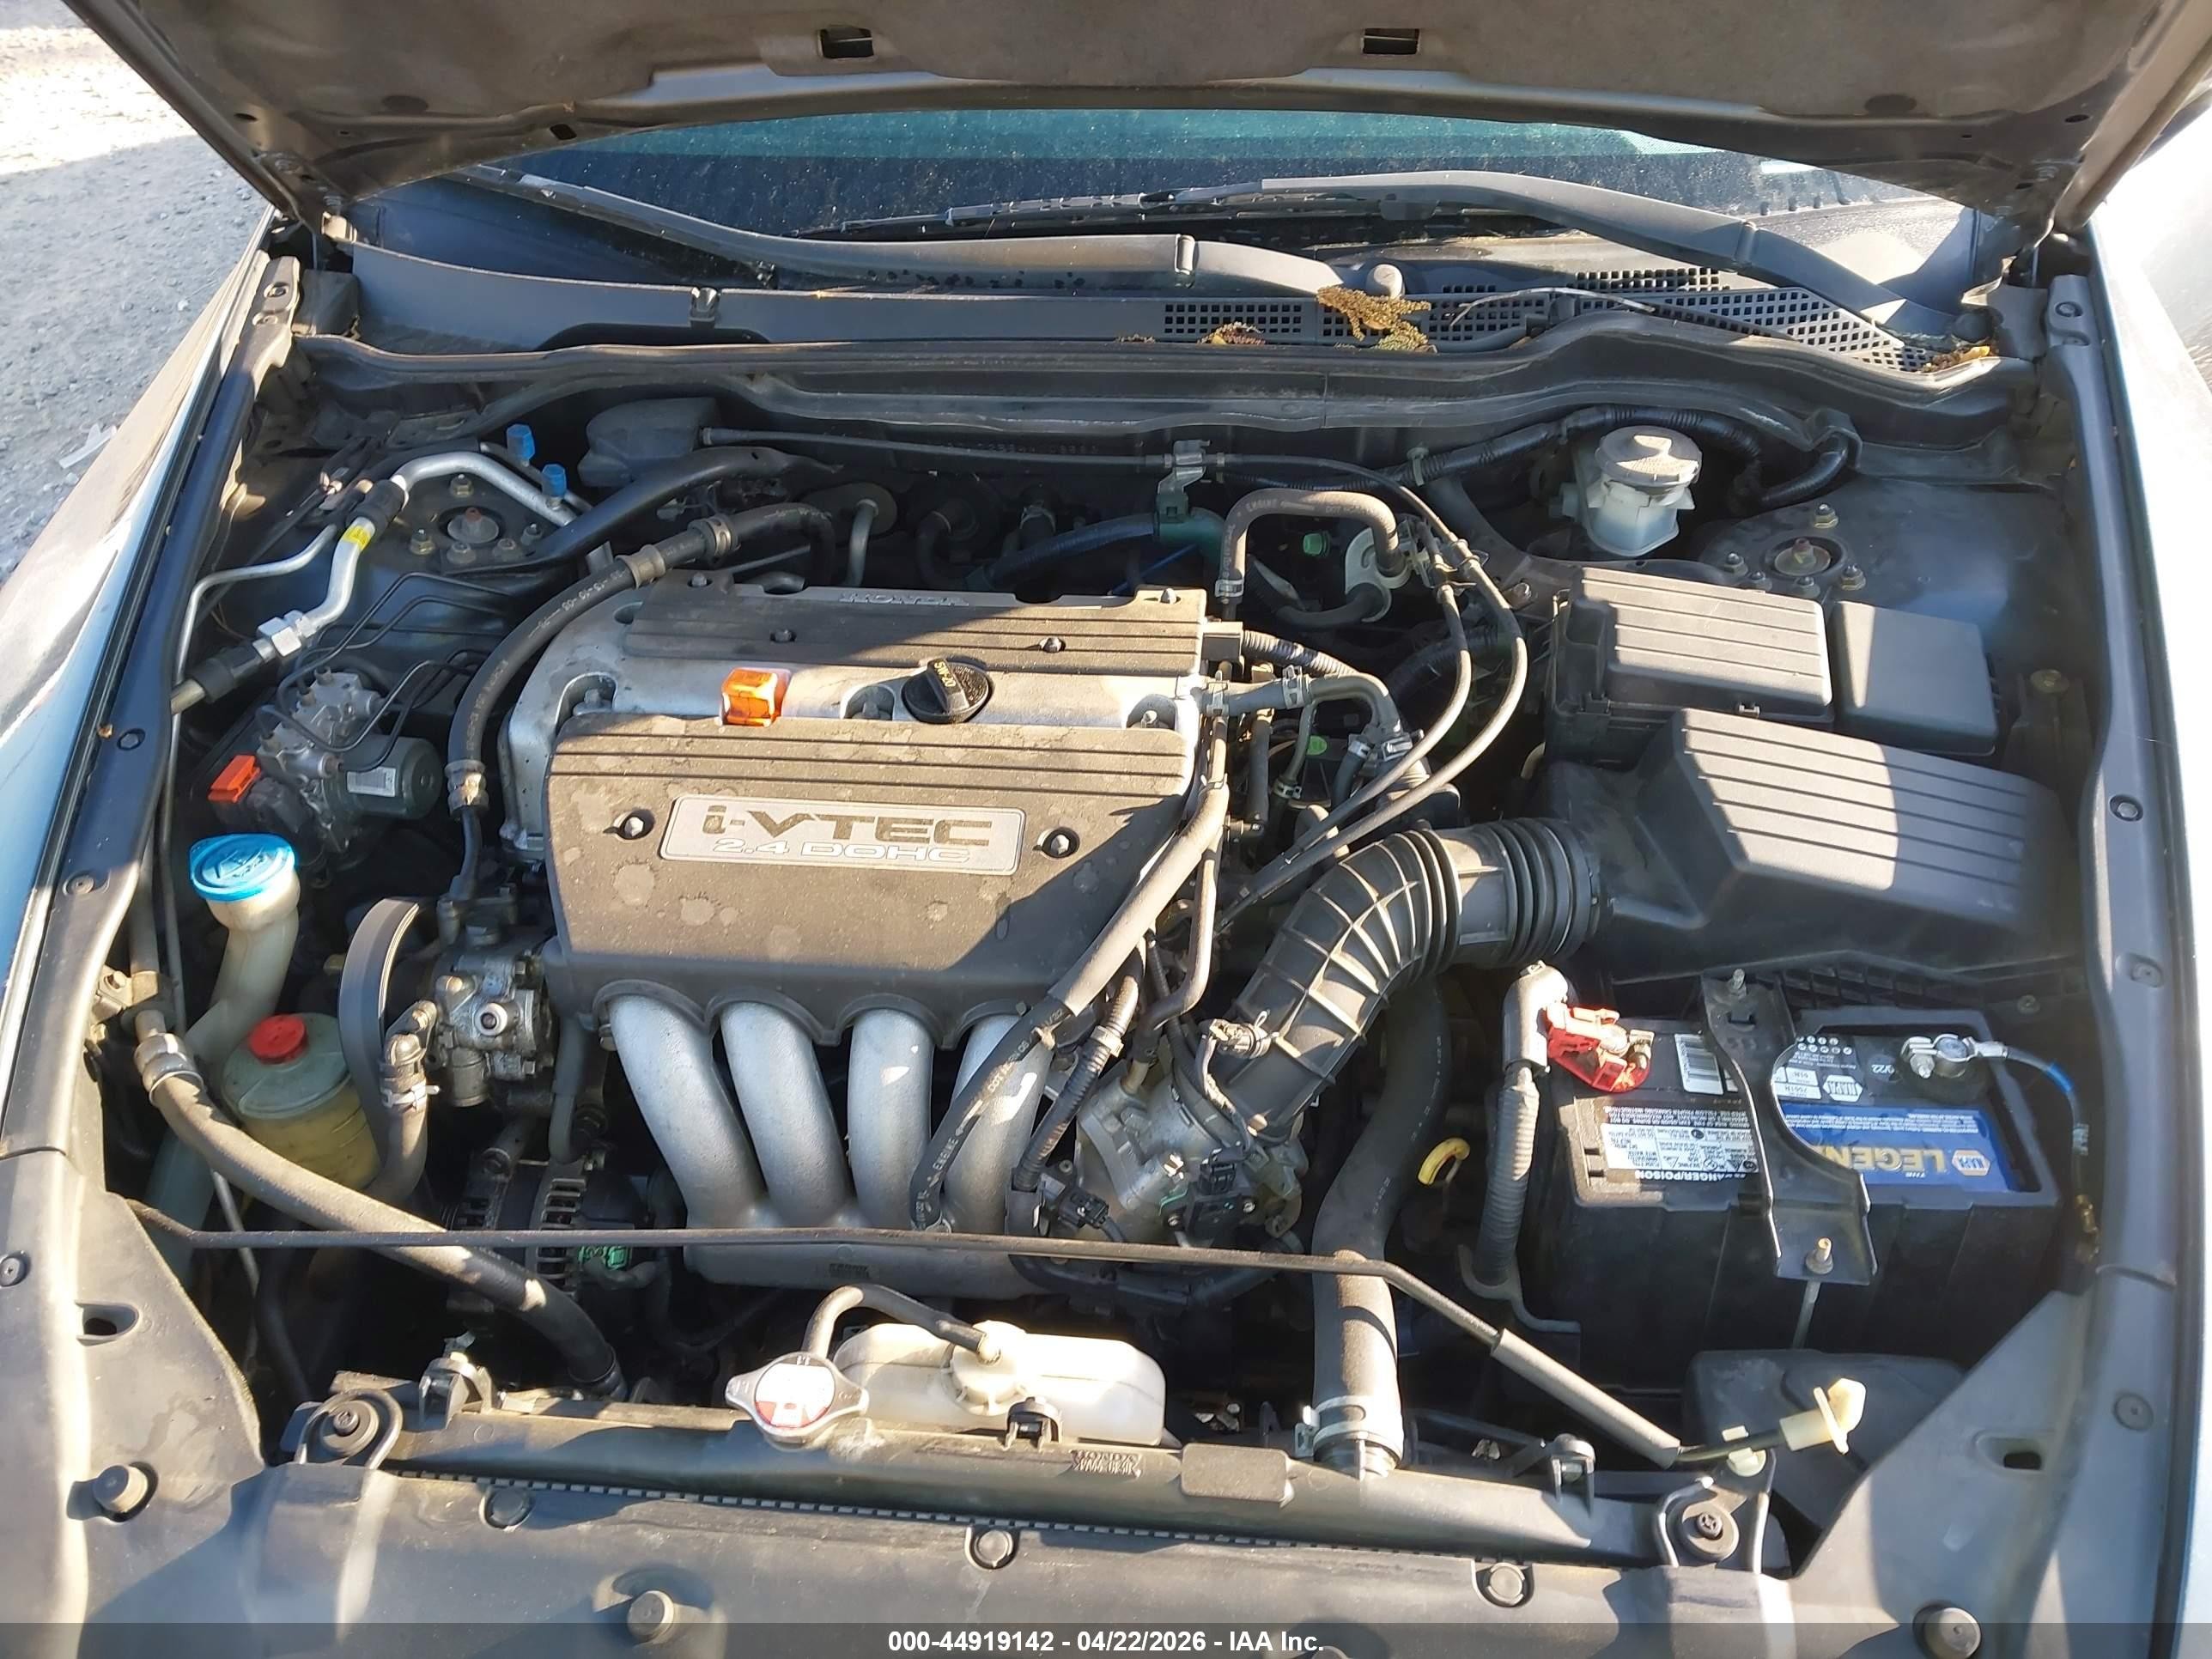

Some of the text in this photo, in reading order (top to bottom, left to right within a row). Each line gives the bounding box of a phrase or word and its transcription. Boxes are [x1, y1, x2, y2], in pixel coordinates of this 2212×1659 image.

[702, 805, 993, 847] i-VTEC
[713, 838, 970, 864] 2.4 DOHC
[1817, 1146, 1947, 1173] LEGEN
